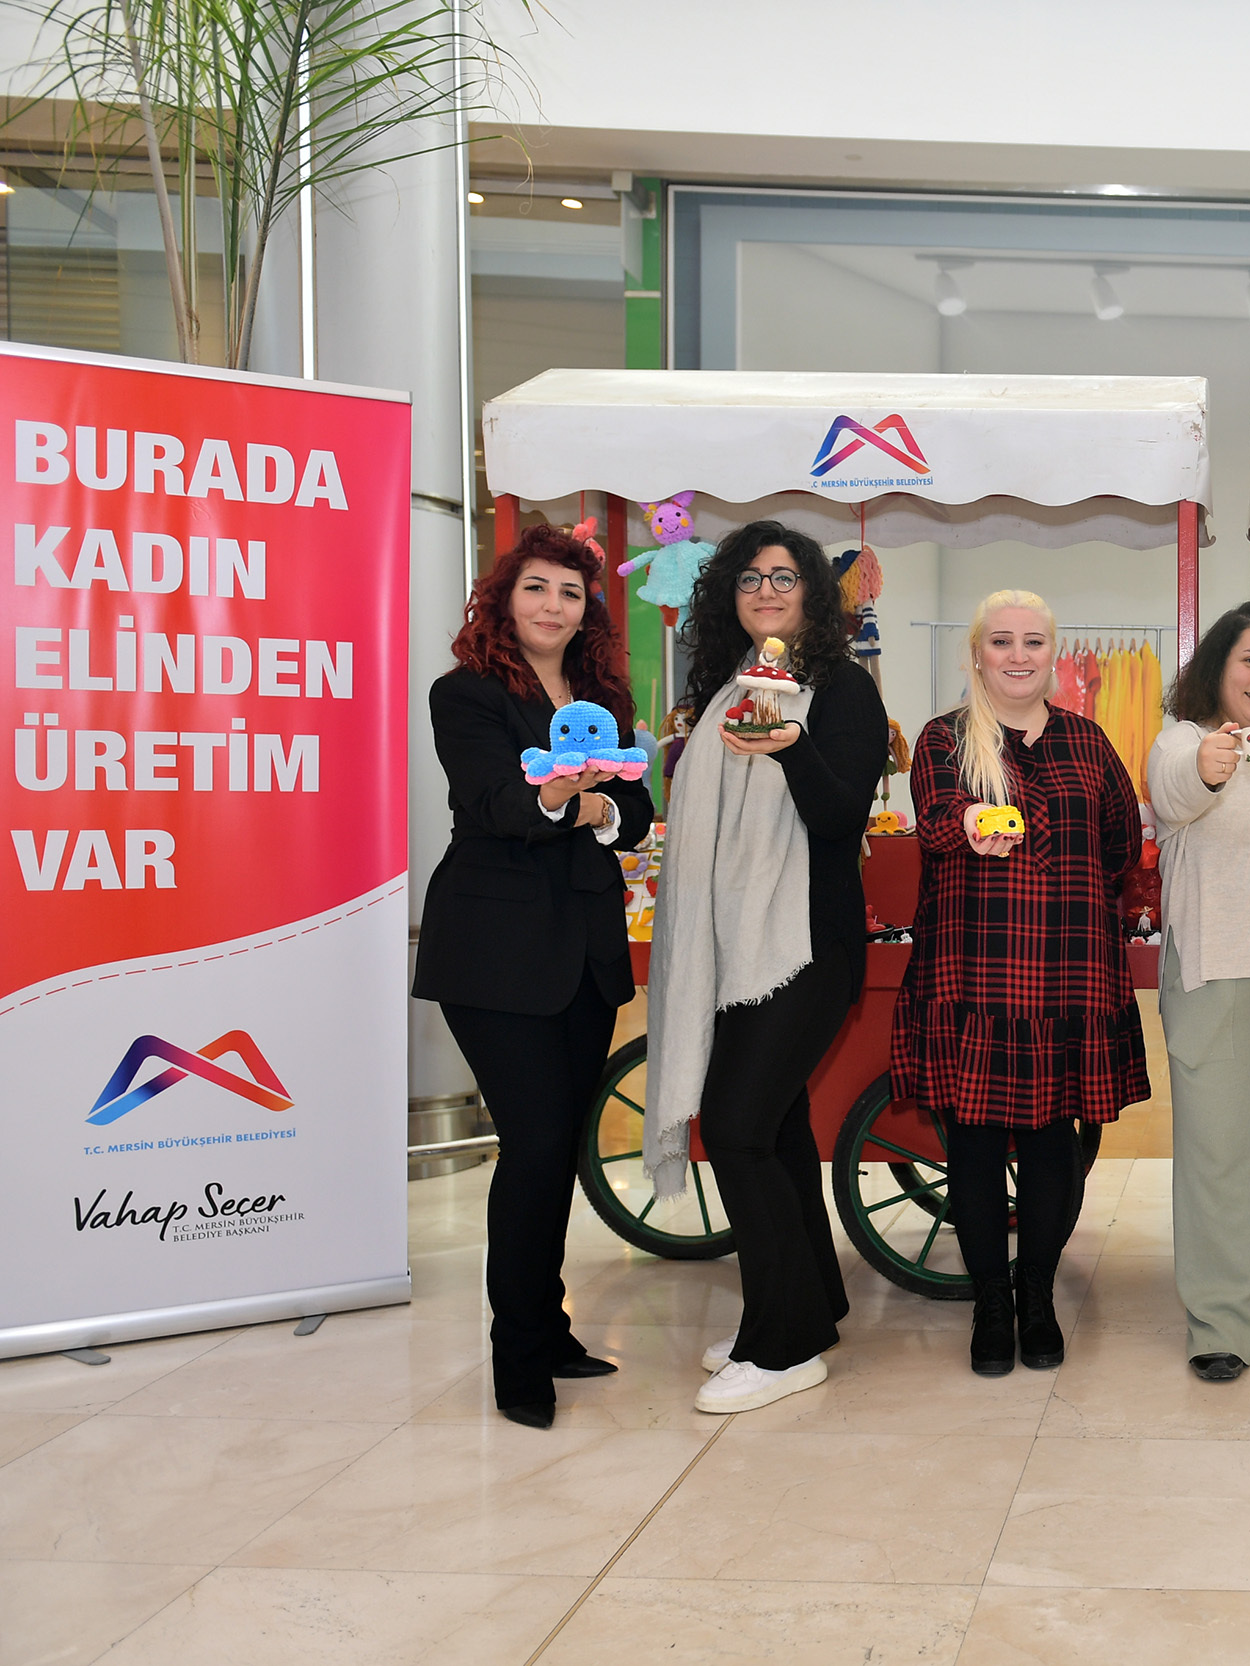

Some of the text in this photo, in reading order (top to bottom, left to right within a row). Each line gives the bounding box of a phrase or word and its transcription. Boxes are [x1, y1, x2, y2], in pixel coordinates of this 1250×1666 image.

[15, 419, 349, 511] BURADA
[821, 478, 848, 488] MERSİN
[849, 477, 894, 489] BÜYÜKŞEHİR
[896, 476, 934, 486] BELEDİYESİ
[14, 523, 266, 600] KADIN
[15, 615, 353, 699] ELİNDEN
[14, 712, 320, 793] ÜRETİM
[10, 829, 177, 891] VAR
[83, 1127, 297, 1155] T.C. MERSİN BÜYÜKŞEHİR BELEDİYESİ
[74, 1182, 286, 1242] Vahap Seçer
[172, 1212, 305, 1233] T.C. MERSİN BÜYÜKŞEHİR
[173, 1225, 270, 1243] BELEDİYE BAŞKANI
